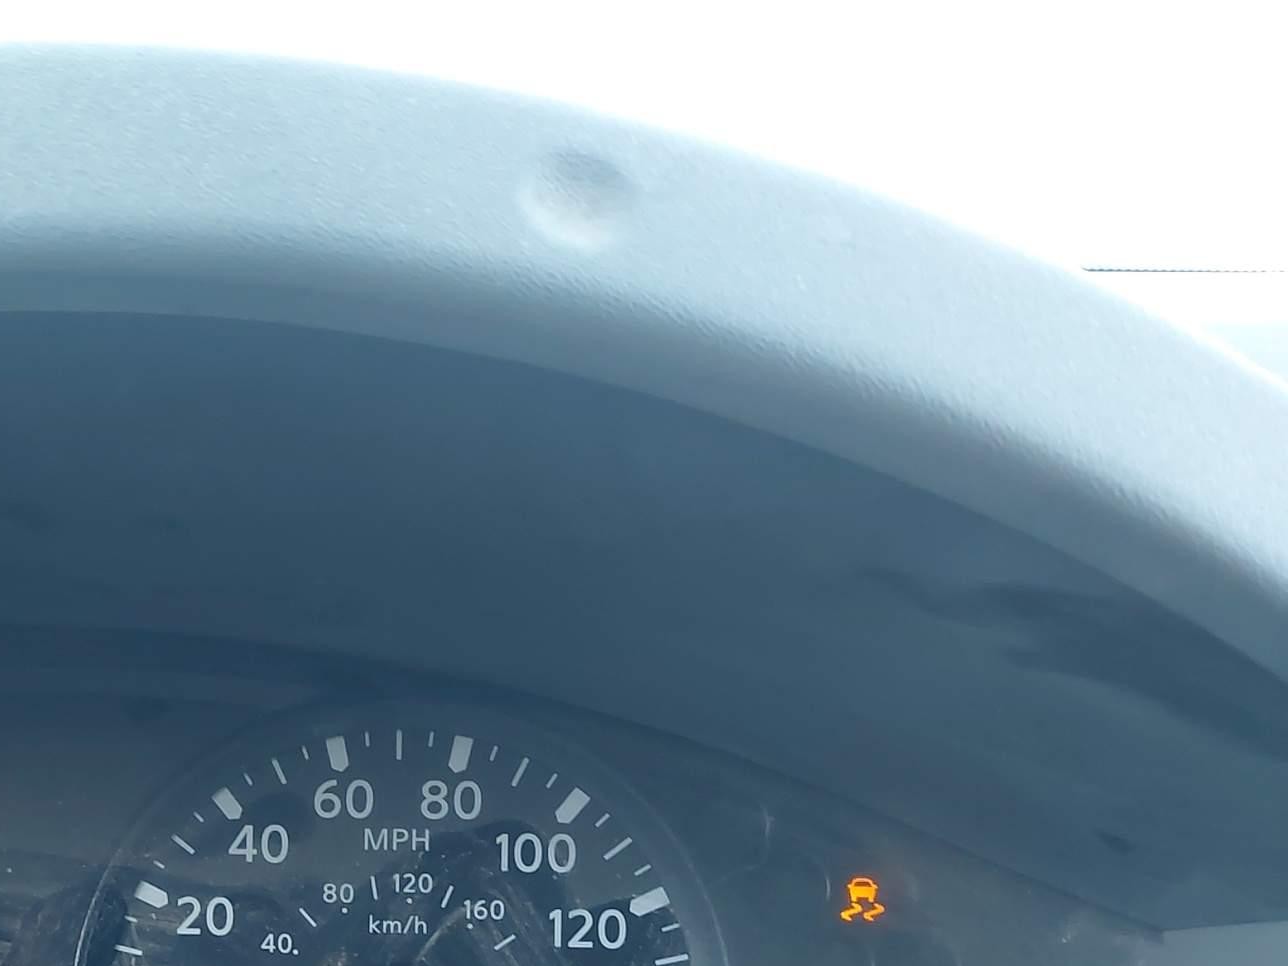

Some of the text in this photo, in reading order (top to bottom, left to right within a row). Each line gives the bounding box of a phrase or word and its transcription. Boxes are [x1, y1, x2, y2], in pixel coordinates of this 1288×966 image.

[314, 780, 374, 819] 60
[420, 780, 482, 820] 80
[228, 824, 289, 863] 40
[364, 829, 430, 851] MPH
[495, 833, 576, 873] 100
[323, 884, 354, 903] 80
[393, 874, 433, 894] 120
[177, 896, 234, 936] 20
[368, 915, 427, 935] km/h
[463, 900, 504, 920] 160
[549, 909, 627, 949] 120
